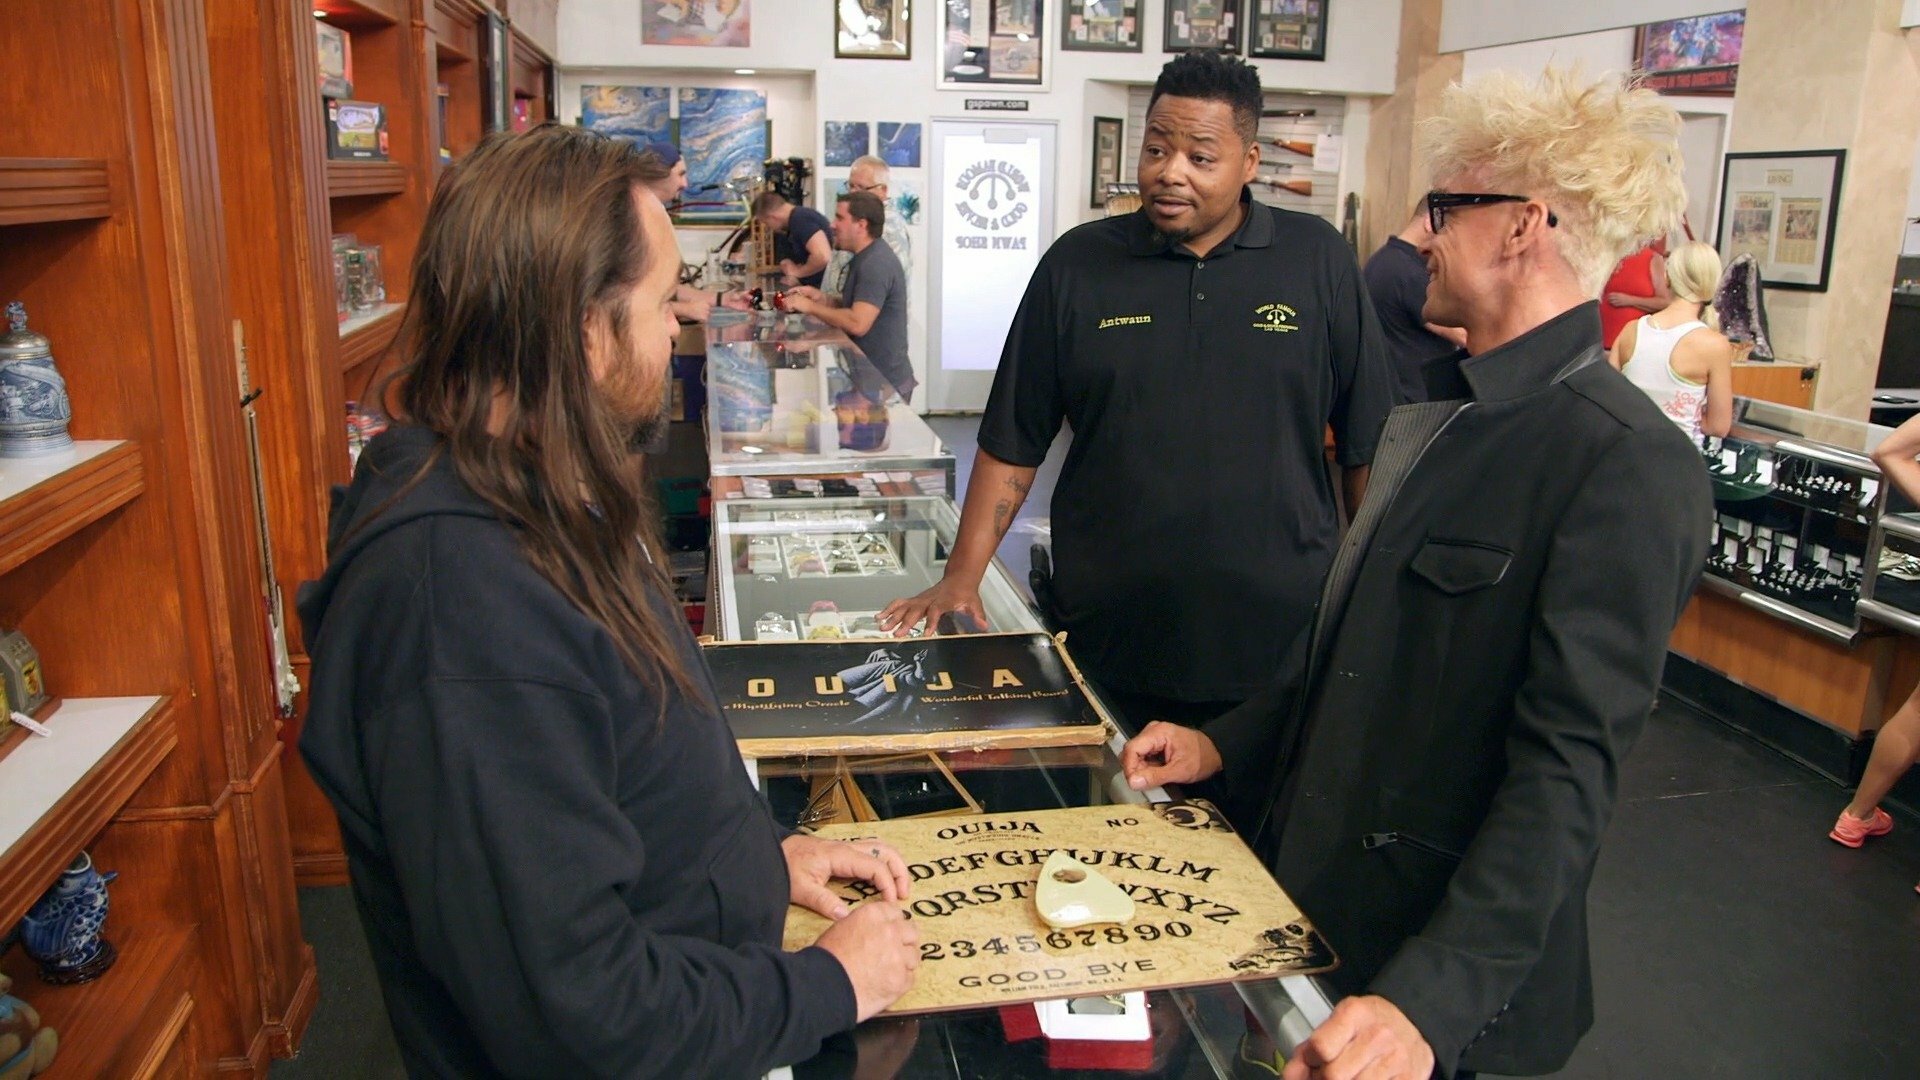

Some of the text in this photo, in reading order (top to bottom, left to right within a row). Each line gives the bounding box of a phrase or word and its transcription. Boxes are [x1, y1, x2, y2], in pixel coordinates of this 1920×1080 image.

[966, 99, 1027, 110] gspawn.com
[1255, 303, 1275, 315] WORLD
[1098, 314, 1152, 329] Antwaun
[747, 668, 1024, 698] OUIJA
[805, 700, 851, 708] Oracle
[920, 694, 983, 703] Wonderful
[986, 692, 1032, 700] Talking
[937, 820, 1044, 840] OUIJA
[1106, 817, 1139, 828] NO
[958, 959, 1157, 988] GOOD BYE
